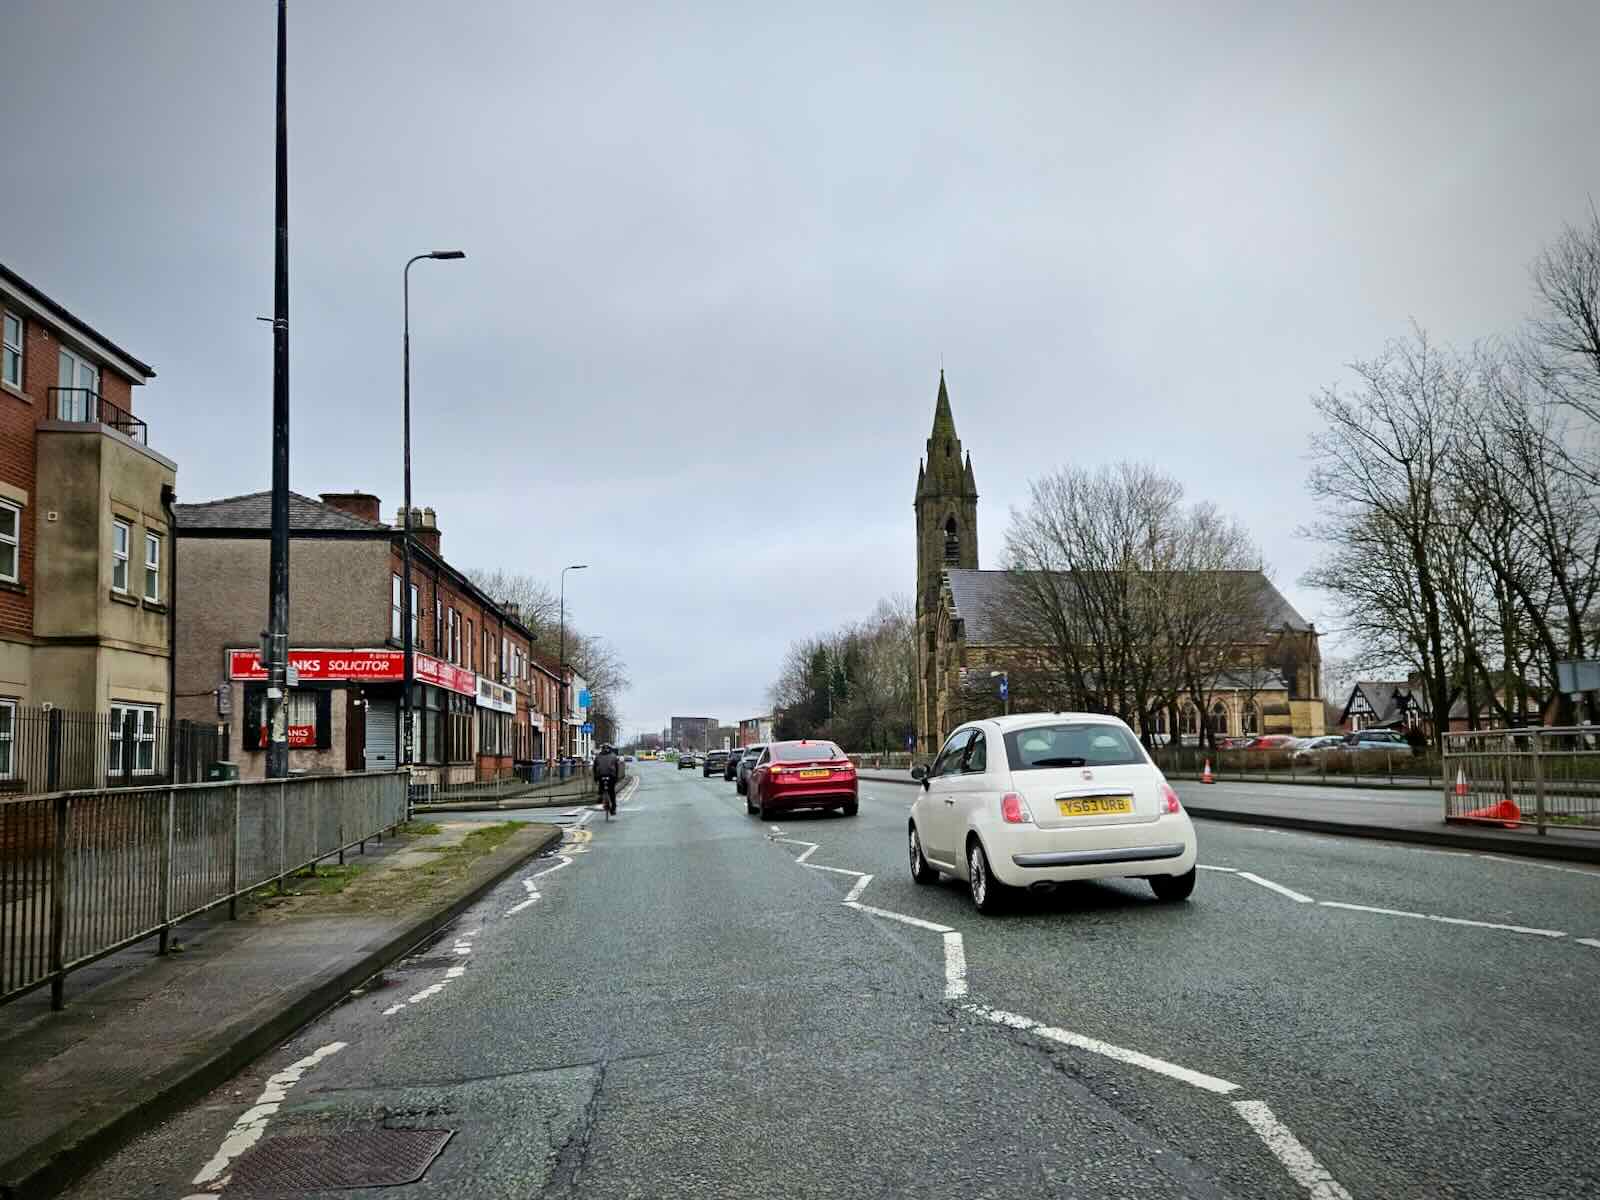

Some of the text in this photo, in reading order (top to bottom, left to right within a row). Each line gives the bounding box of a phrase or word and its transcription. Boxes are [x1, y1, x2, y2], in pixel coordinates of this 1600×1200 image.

[328, 660, 389, 671] SOLICITOR
[1064, 799, 1125, 813] YS63 URB
